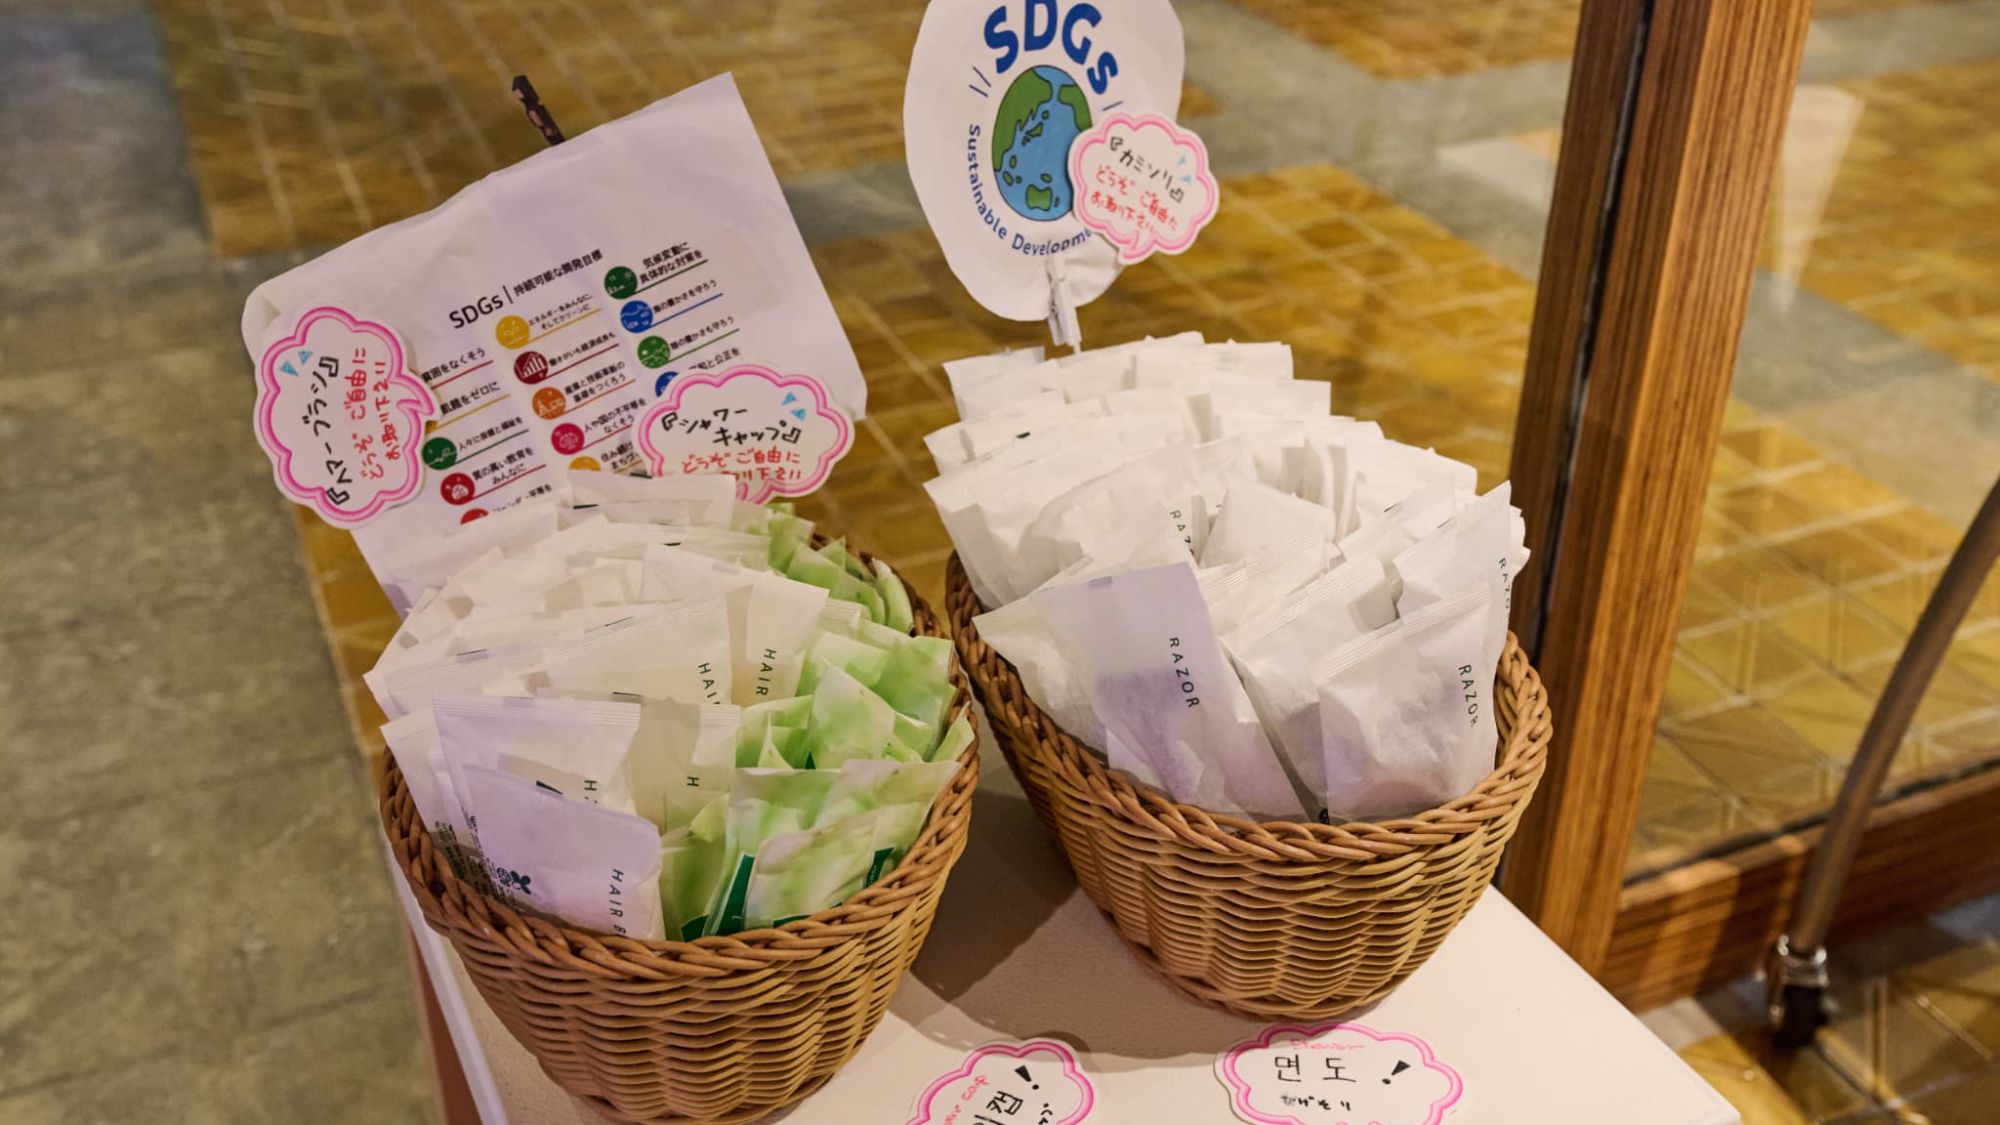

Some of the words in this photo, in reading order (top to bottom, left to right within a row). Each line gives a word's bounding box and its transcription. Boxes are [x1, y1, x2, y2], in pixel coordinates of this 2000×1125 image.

[983, 0, 1119, 95] SDGs
[967, 124, 1007, 239] Sustainable
[639, 250, 703, 285] 具体的な対策を
[643, 242, 691, 269] 気候変動に
[449, 294, 504, 329] SDGs
[513, 248, 603, 297] 持続可能な開発目標
[653, 279, 718, 314] 海の豊かさを守ろう
[670, 315, 735, 350] 陸の豊かさも守ろう
[421, 347, 486, 383] 貧困をなくそう
[688, 346, 741, 370] 和と公正を
[440, 381, 501, 415] 飢餓をゼロに
[584, 397, 647, 433] 人や国の不平等を
[458, 416, 524, 451] 人々に保健と福祉を
[603, 414, 635, 434] なくそう
[472, 446, 535, 482] 質の高い教育を
[492, 463, 525, 485] みんなに
[697, 662, 721, 705] HAI
[755, 648, 777, 696] HAIR
[1169, 637, 1200, 708] RAZOR
[609, 868, 624, 918] HAIR
